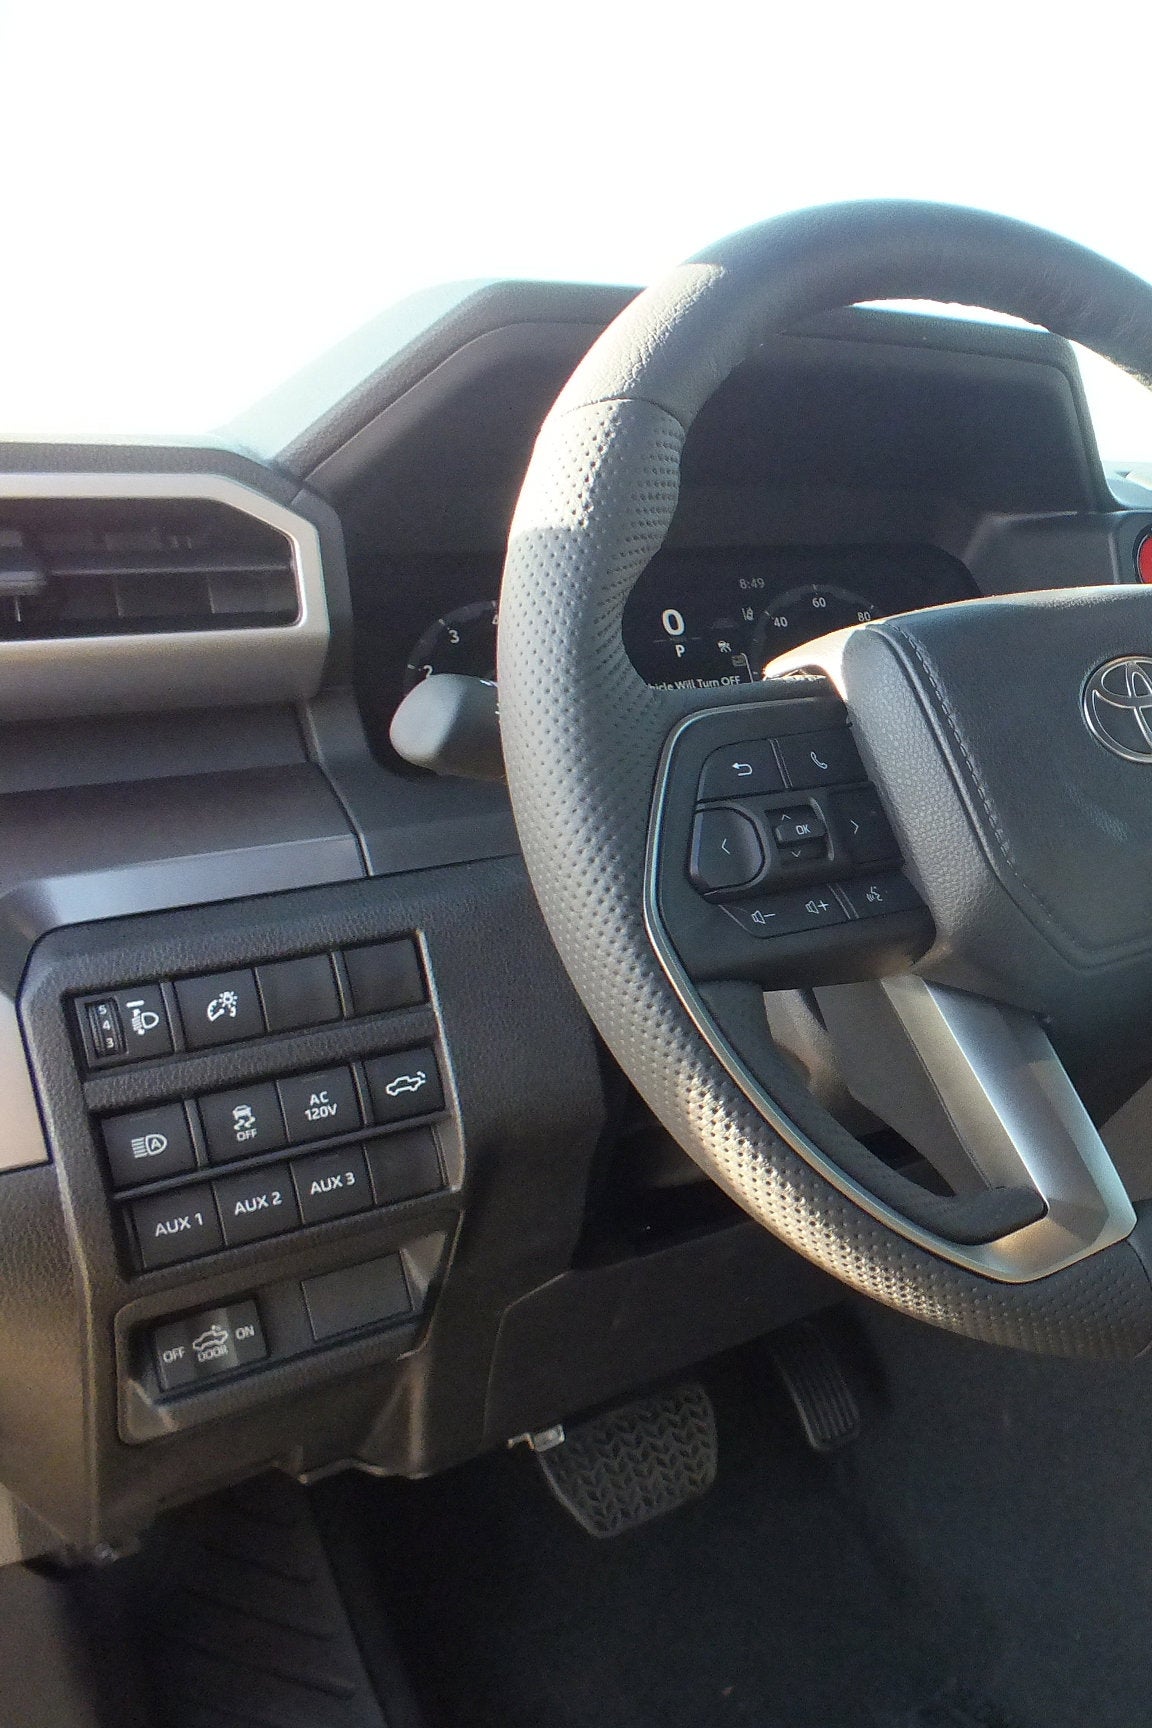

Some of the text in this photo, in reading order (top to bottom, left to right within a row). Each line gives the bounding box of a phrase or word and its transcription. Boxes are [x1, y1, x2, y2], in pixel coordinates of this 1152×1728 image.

[739, 577, 765, 590] 8:49
[812, 597, 827, 608] 60
[662, 608, 686, 637] 0
[773, 616, 788, 628] 40
[857, 611, 871, 622] 80
[449, 629, 460, 644] 3
[676, 644, 686, 658] P
[674, 679, 695, 690] Will
[696, 678, 719, 689] Turn
[720, 675, 740, 686] OFF
[796, 824, 811, 835] OK
[99, 1004, 107, 1015] 5
[102, 1019, 111, 1031] 4
[106, 1037, 114, 1048] 3
[309, 1091, 330, 1106] AC
[304, 1103, 338, 1121] 120V
[236, 1128, 258, 1142] OFF
[310, 1171, 356, 1196] AUX 3
[234, 1191, 283, 1216] AUX 2
[155, 1212, 203, 1237] AUX 1
[235, 1324, 255, 1341] ON
[163, 1345, 185, 1364] OFF
